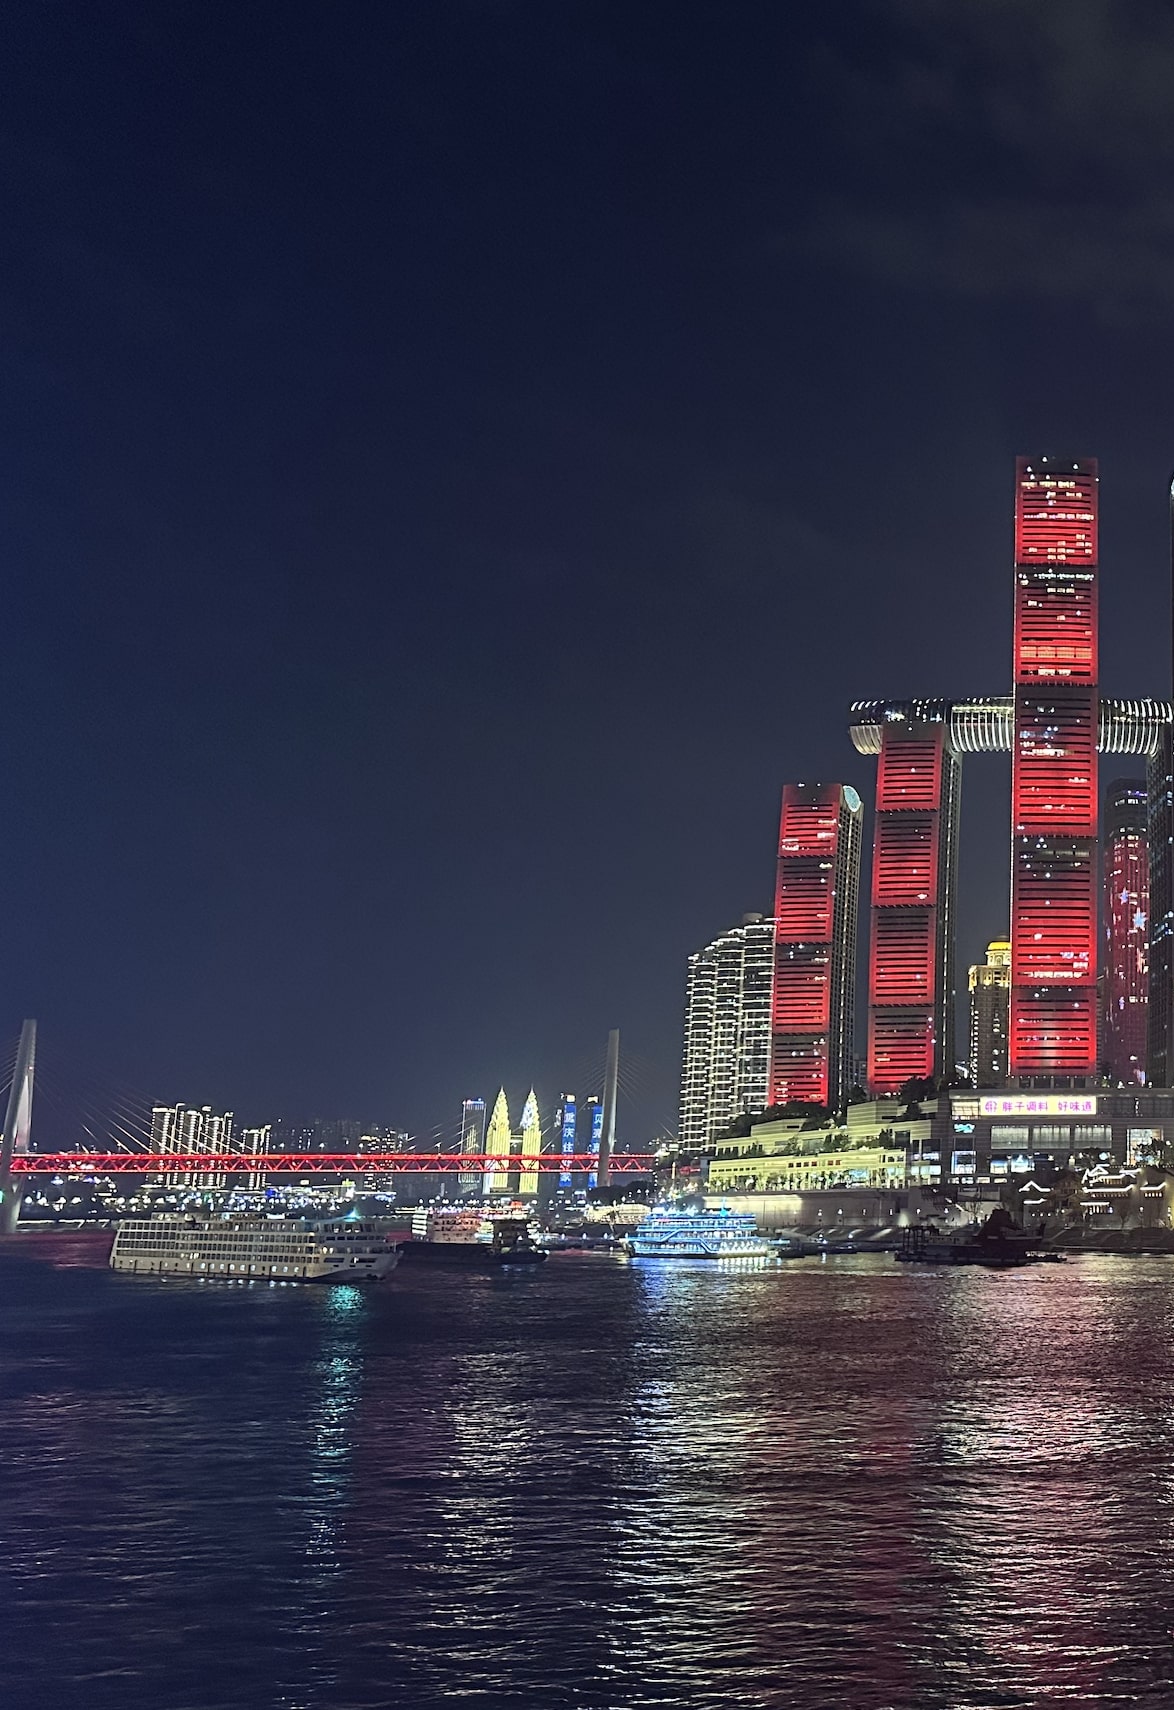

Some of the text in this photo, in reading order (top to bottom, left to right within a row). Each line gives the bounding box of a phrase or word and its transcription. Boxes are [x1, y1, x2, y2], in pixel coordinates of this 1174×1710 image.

[1003, 1101, 1091, 1111] 胖子调料 好味道
